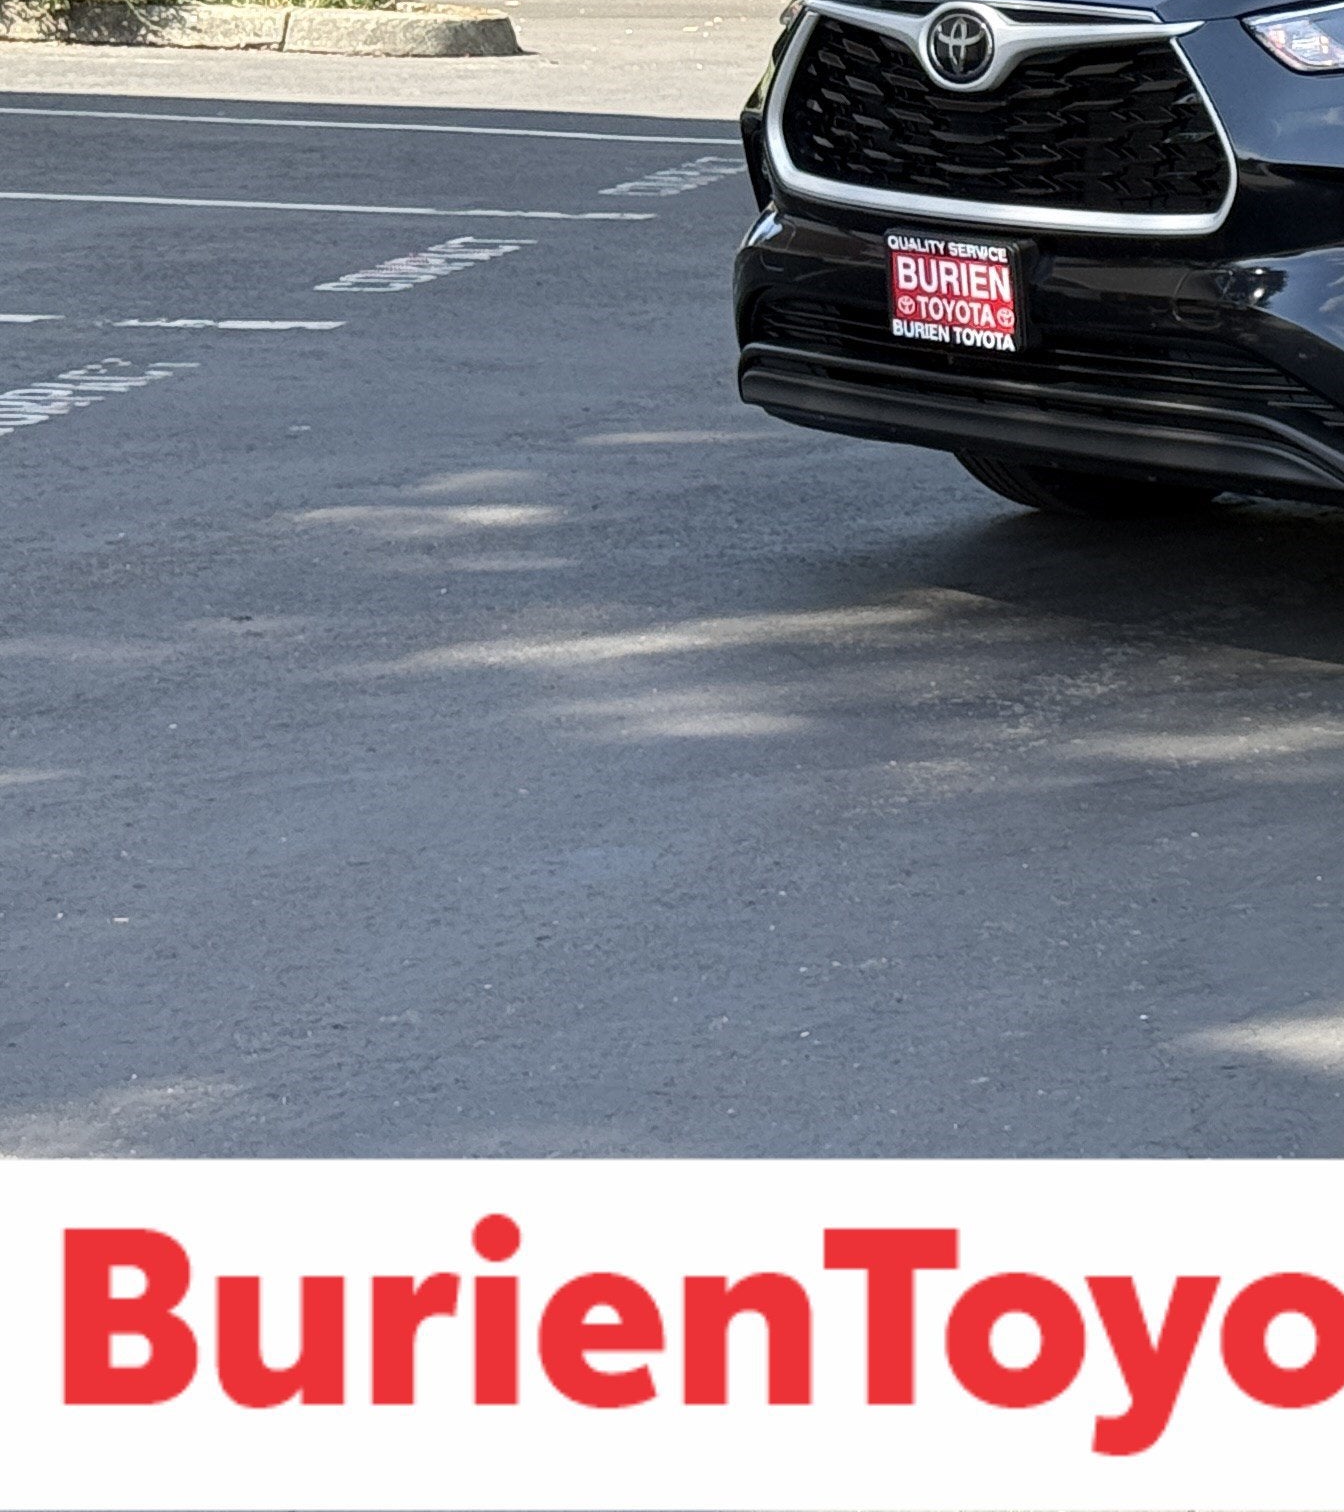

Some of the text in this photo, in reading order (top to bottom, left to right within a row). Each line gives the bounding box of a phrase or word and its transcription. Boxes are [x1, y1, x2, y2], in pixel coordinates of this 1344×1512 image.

[888, 235, 1008, 263] QUALITY SERVICE
[896, 255, 1012, 302] BURIEN
[916, 295, 996, 328] TOYOTA
[892, 318, 1016, 352] BURIEN TOYOTA
